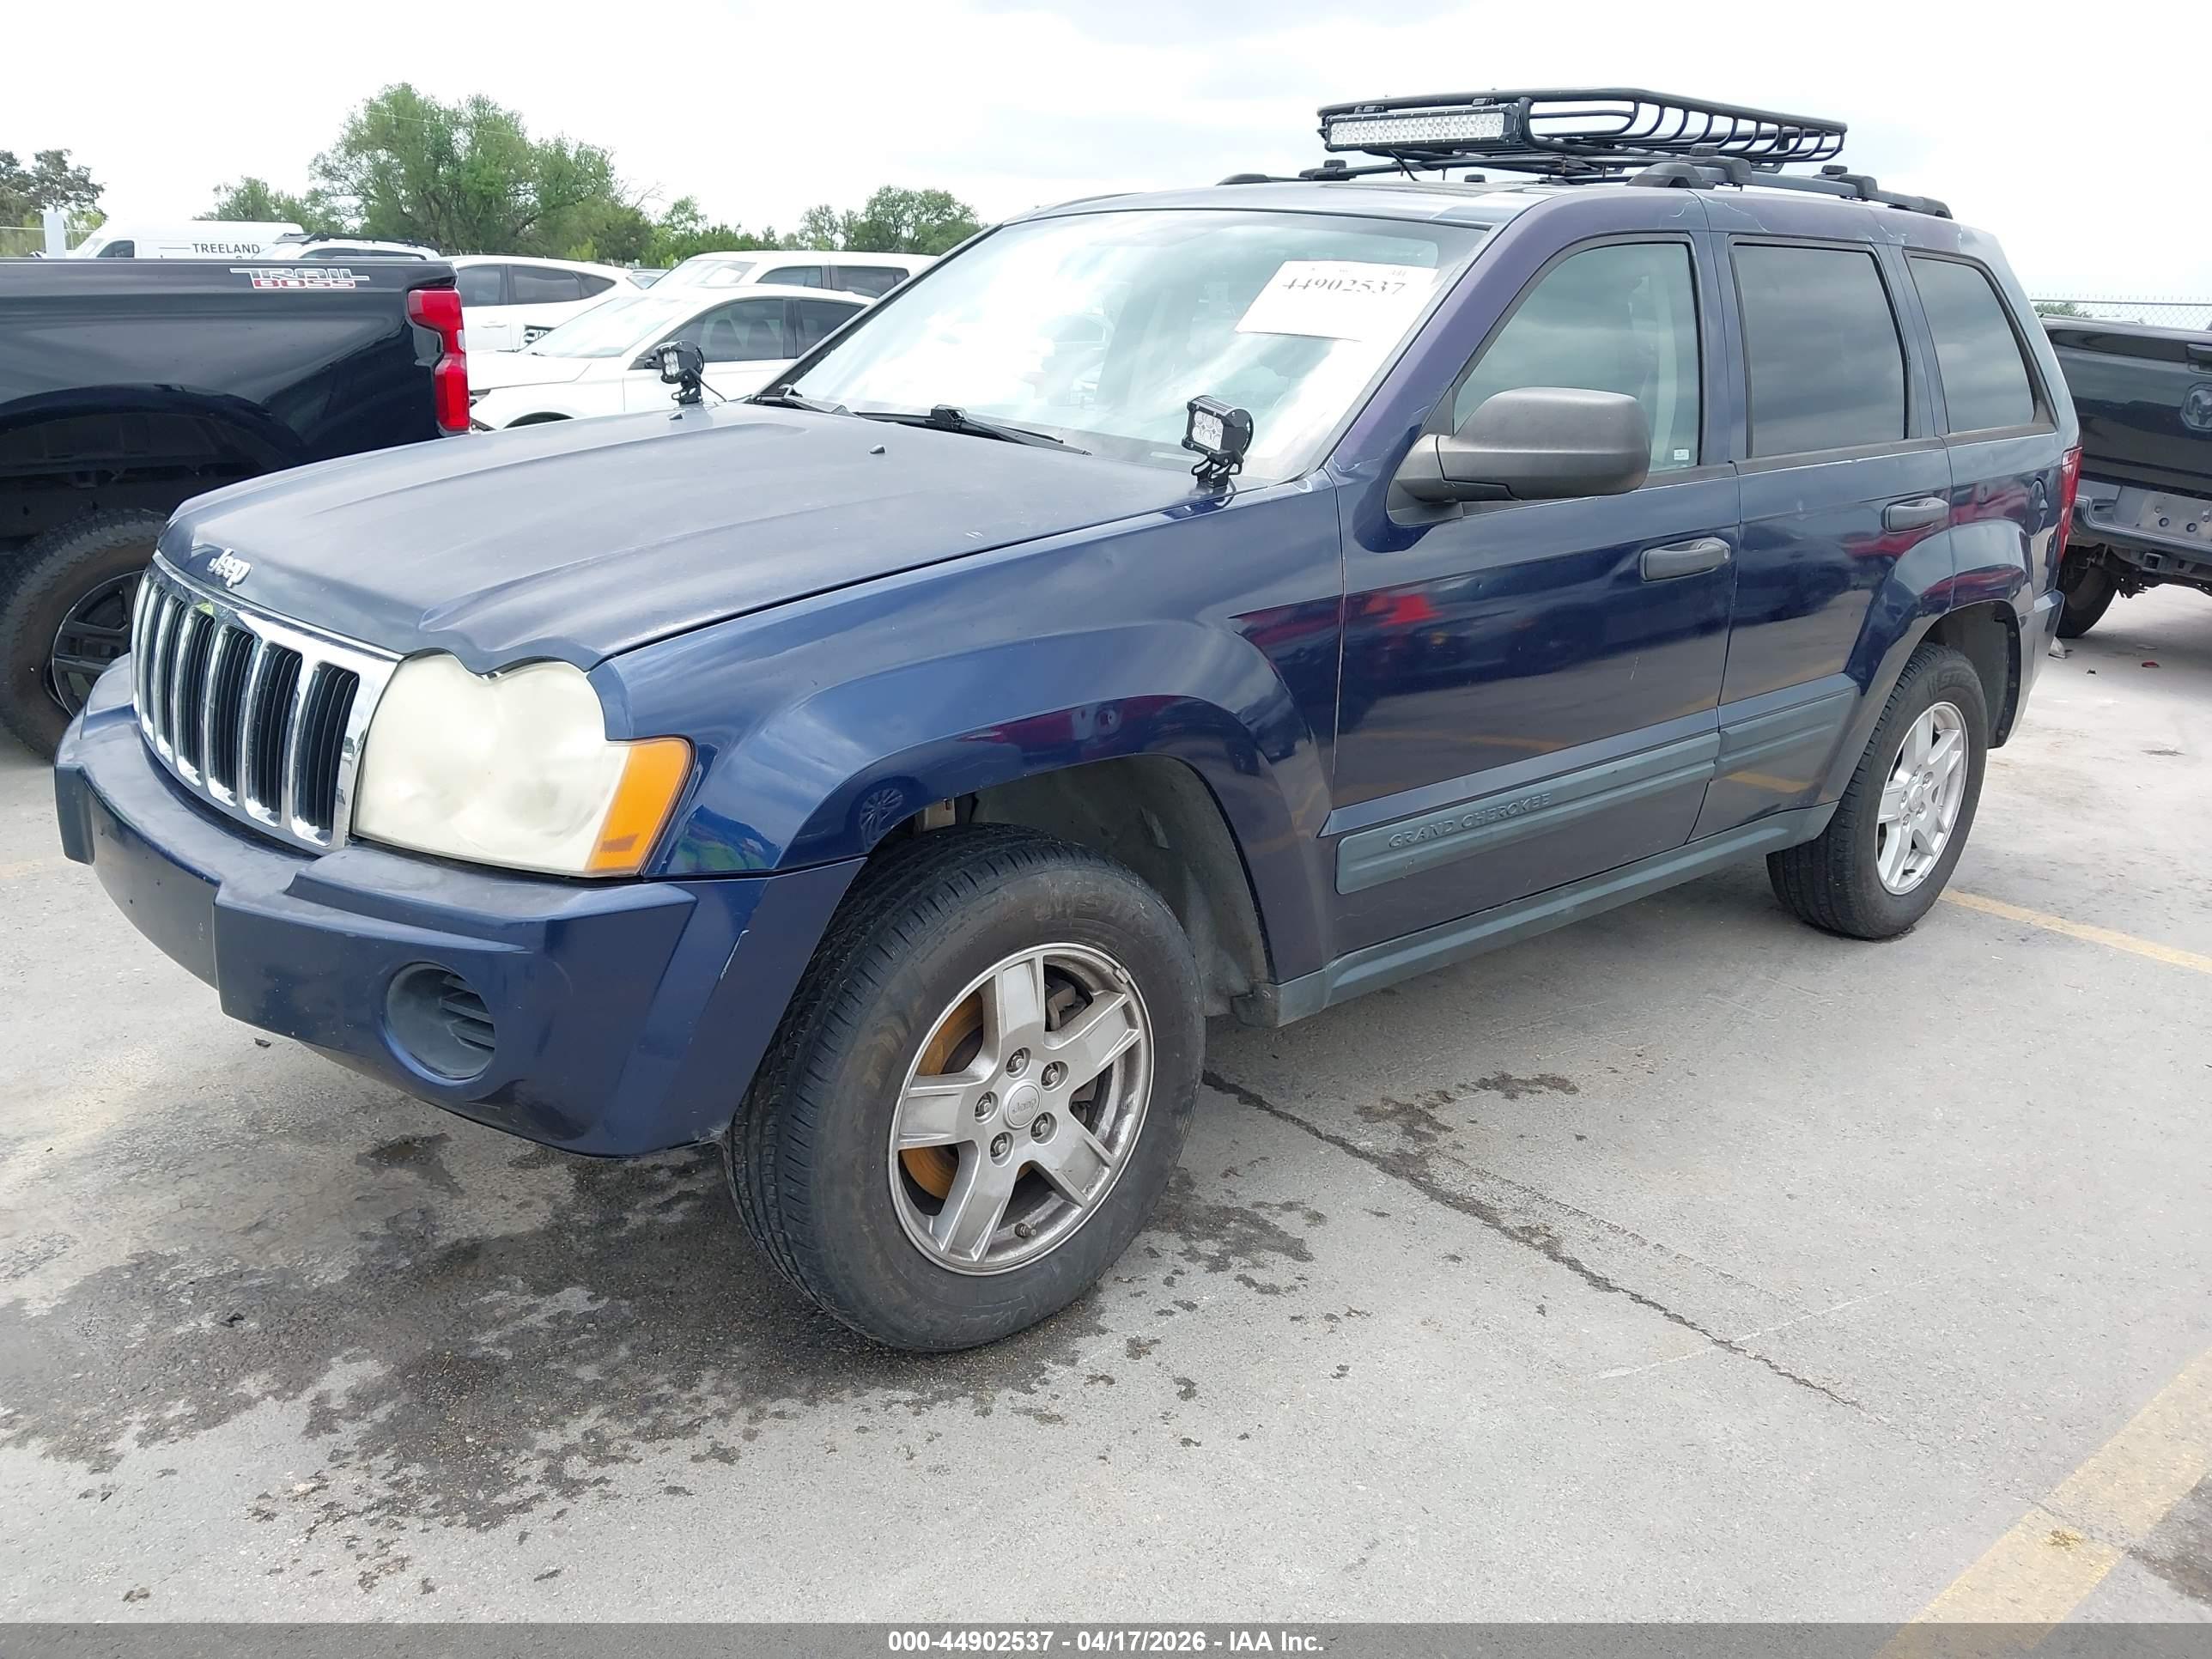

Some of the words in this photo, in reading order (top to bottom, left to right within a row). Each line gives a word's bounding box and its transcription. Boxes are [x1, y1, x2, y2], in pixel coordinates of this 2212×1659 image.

[192, 243, 260, 254] TREELAND
[229, 267, 370, 281] TRAIL
[252, 278, 356, 289] BOSS
[1283, 277, 1406, 295] 44902537
[206, 547, 252, 588] Jeep
[1389, 819, 1455, 848] GRAND
[1461, 793, 1552, 830] CHEROKEE
